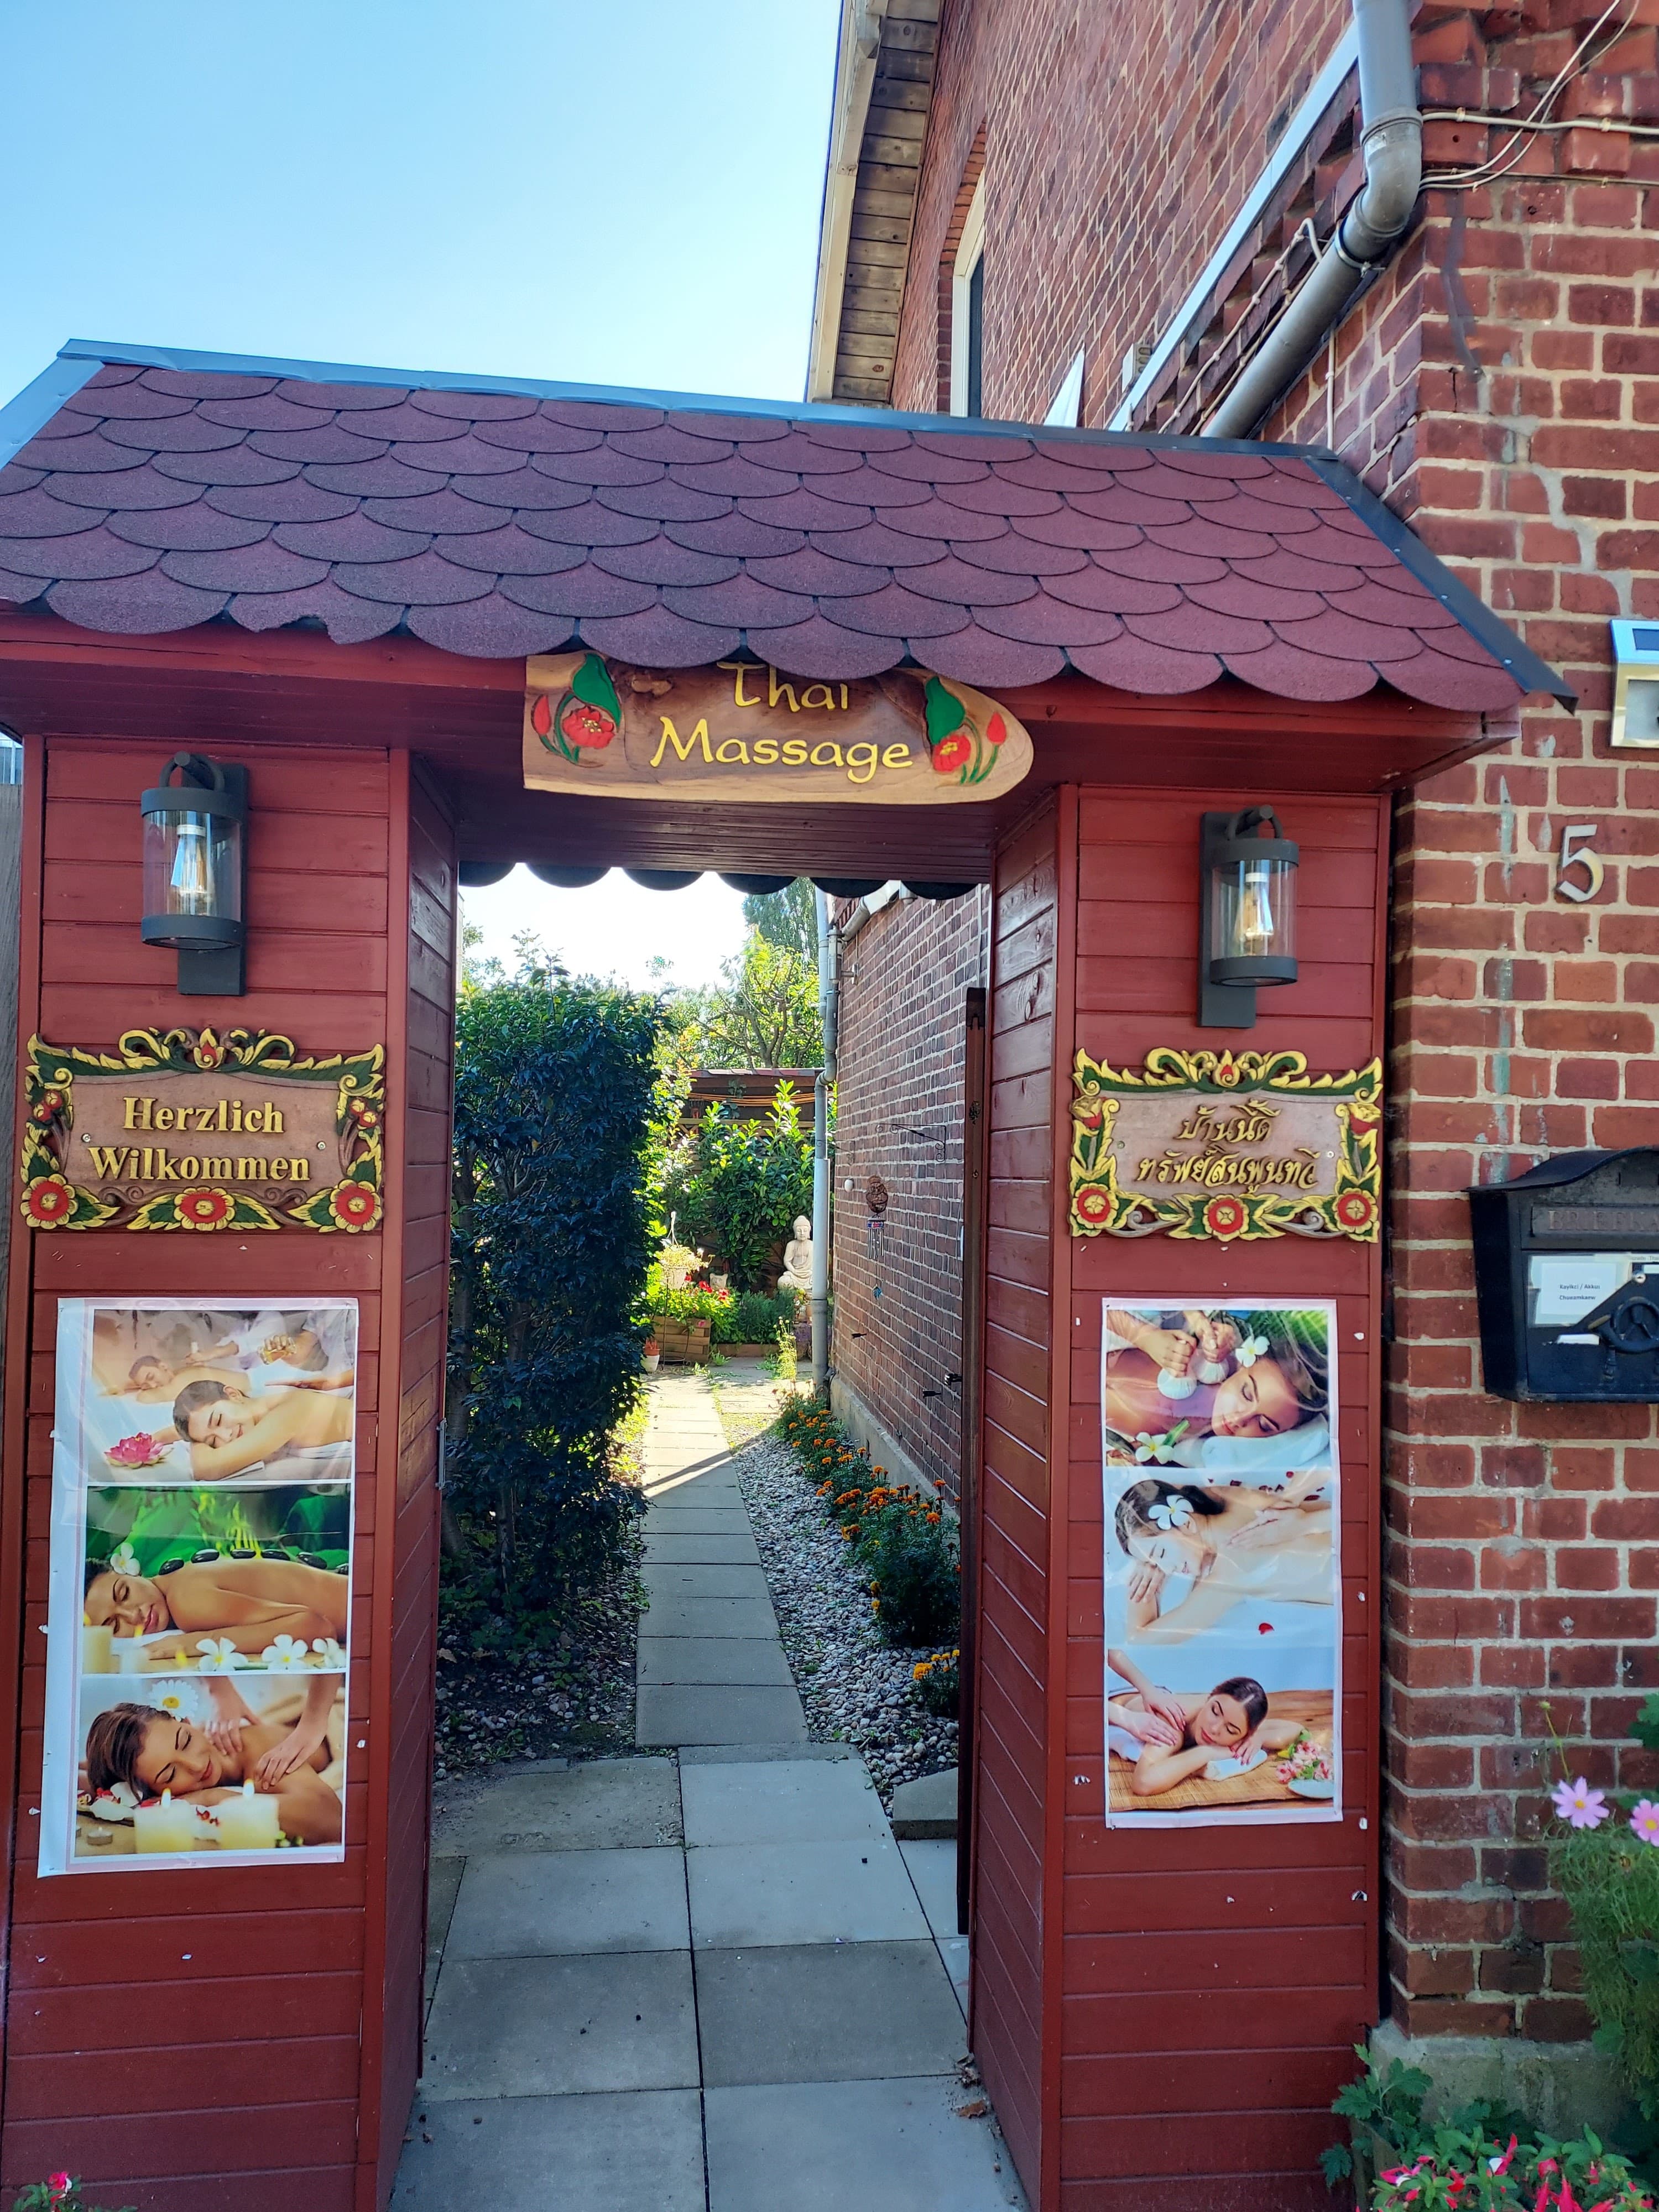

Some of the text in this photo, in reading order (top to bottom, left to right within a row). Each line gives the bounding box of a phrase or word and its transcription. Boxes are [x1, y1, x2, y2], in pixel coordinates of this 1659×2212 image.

[717, 661, 848, 713] Thai
[650, 716, 914, 784] Massage
[1557, 824, 1604, 902] 5
[122, 1097, 285, 1134] Herzlich
[88, 1146, 311, 1182] Wilkommen
